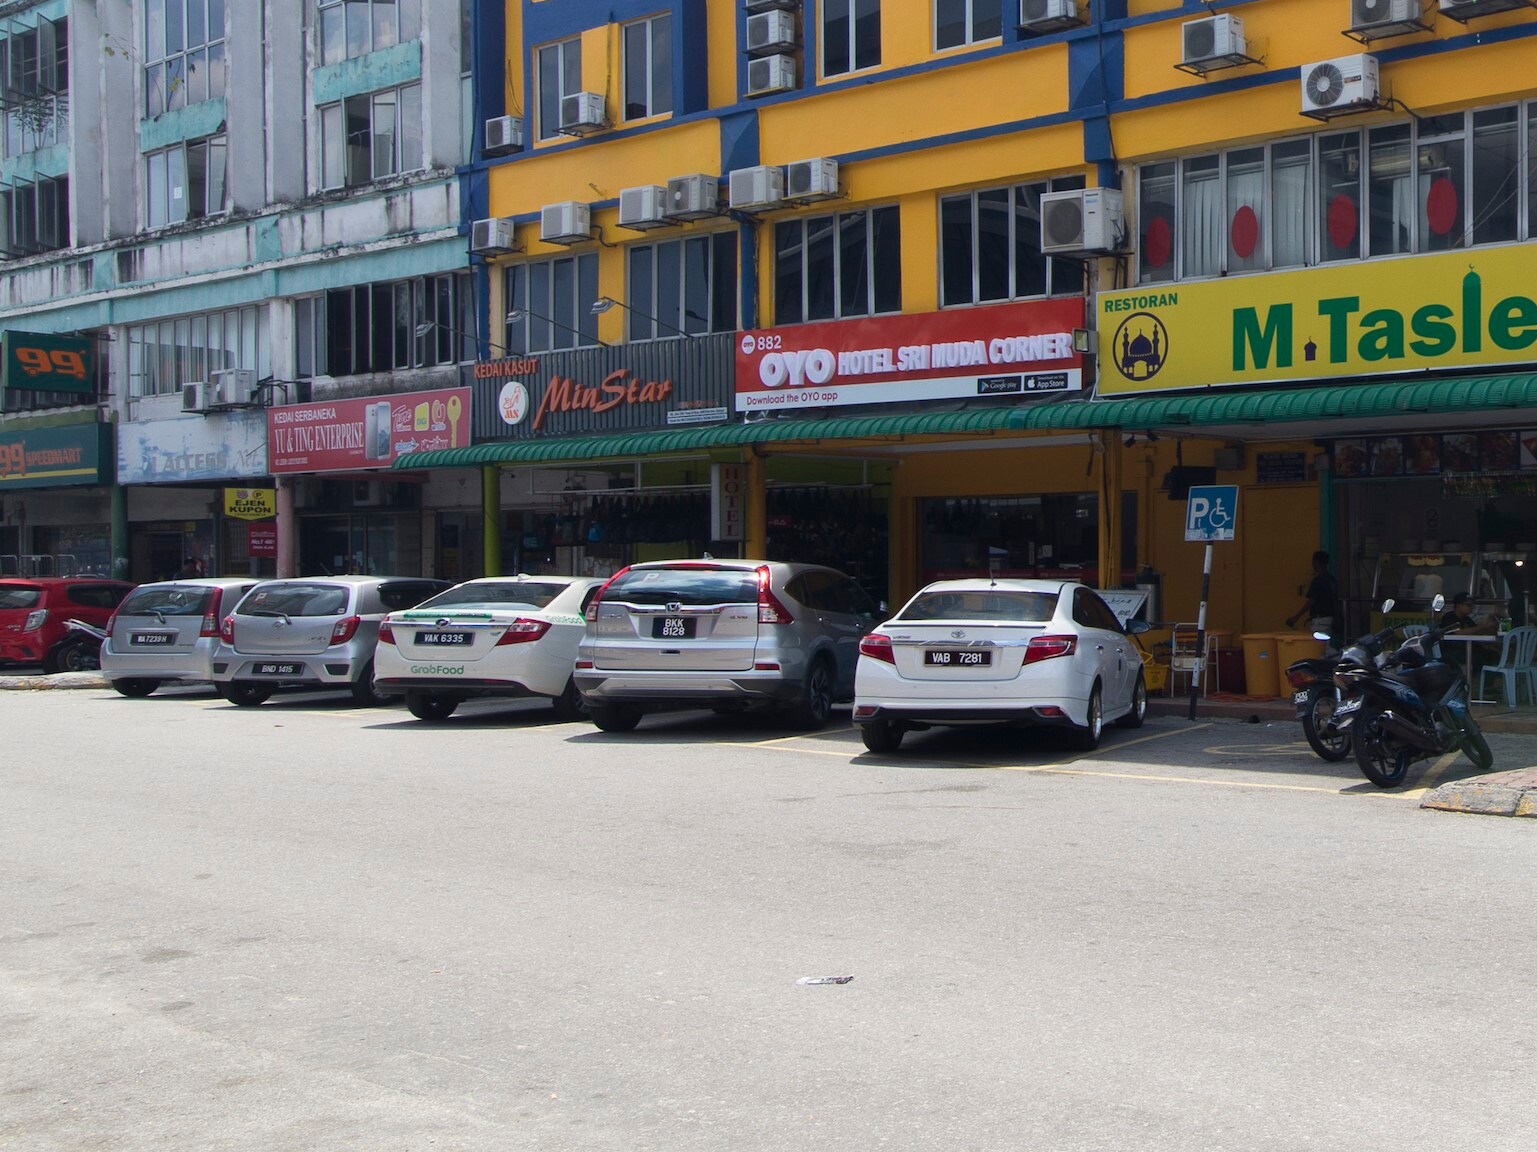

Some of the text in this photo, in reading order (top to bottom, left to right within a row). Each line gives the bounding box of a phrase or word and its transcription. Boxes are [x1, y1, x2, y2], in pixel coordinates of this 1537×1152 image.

[1104, 292, 1179, 313] RESTORAN
[757, 334, 782, 351] 882
[16, 348, 86, 380] 99
[759, 332, 1074, 388] OYO HOTEL SRI MUDA CORNER
[474, 357, 540, 380] KEDAI KASUT
[990, 381, 1006, 390] Google
[1036, 379, 1065, 388] App Store
[746, 391, 838, 406] Download the OYO app
[274, 407, 337, 424] KEDAI SERBANEKA
[286, 427, 294, 453] &
[315, 422, 364, 451] ENTERPRISE
[26, 448, 82, 466] SPEEDMART
[235, 499, 265, 507] EJEN
[724, 468, 740, 537] HOTEL
[1189, 497, 1210, 529] P
[545, 615, 583, 625] GrabFood
[664, 618, 684, 627] BKK
[424, 634, 464, 643] VAK 6335
[662, 627, 685, 636] 8128
[932, 652, 982, 663] VAB 7281
[262, 665, 293, 673] BND 1415
[410, 664, 465, 675] GrabFood
